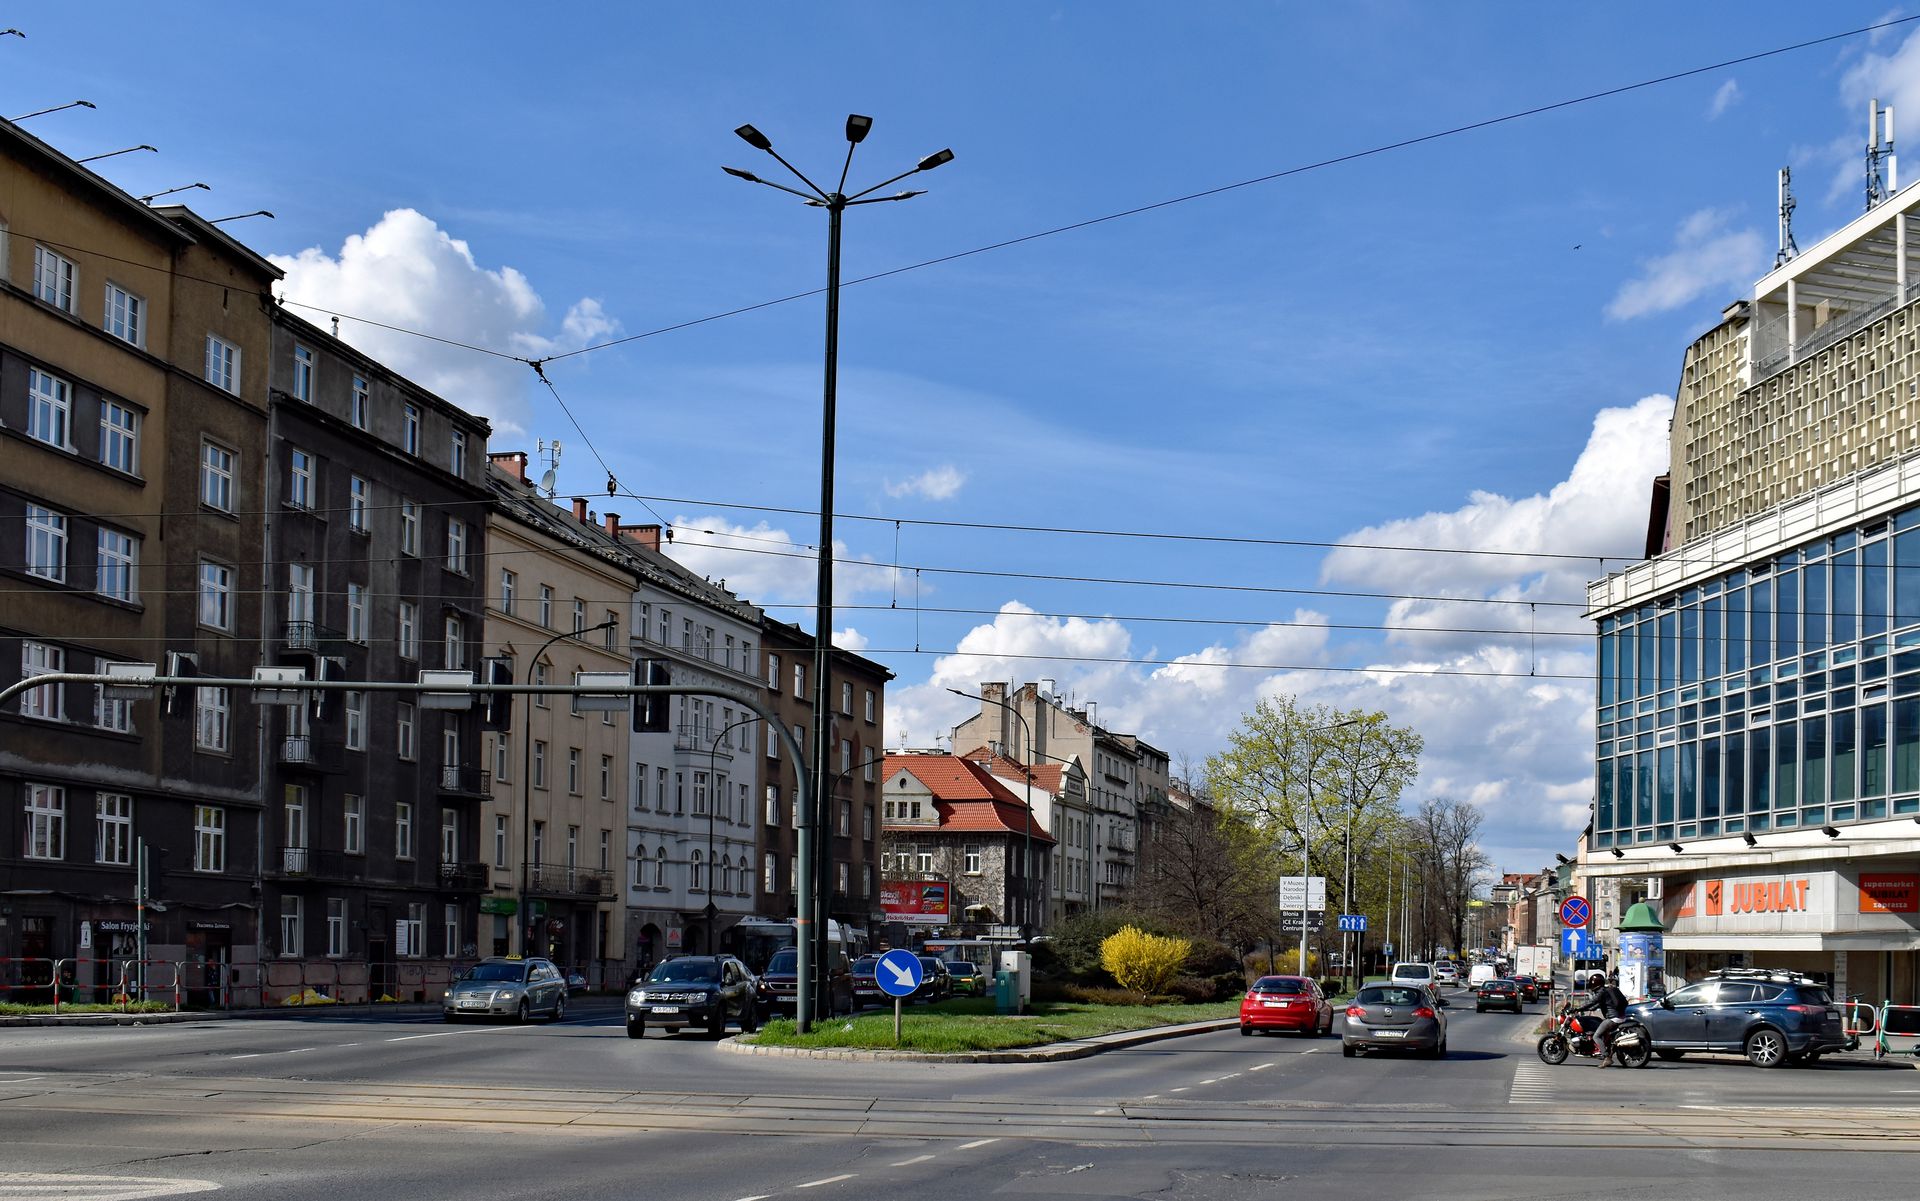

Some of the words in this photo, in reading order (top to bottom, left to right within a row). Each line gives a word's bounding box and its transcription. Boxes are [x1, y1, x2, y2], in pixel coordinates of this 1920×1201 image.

[1731, 880, 1810, 914] JUBILAT
[1869, 890, 1909, 899] JUBILAT
[101, 922, 119, 930] Salon
[120, 922, 150, 932] Fryzjeki
